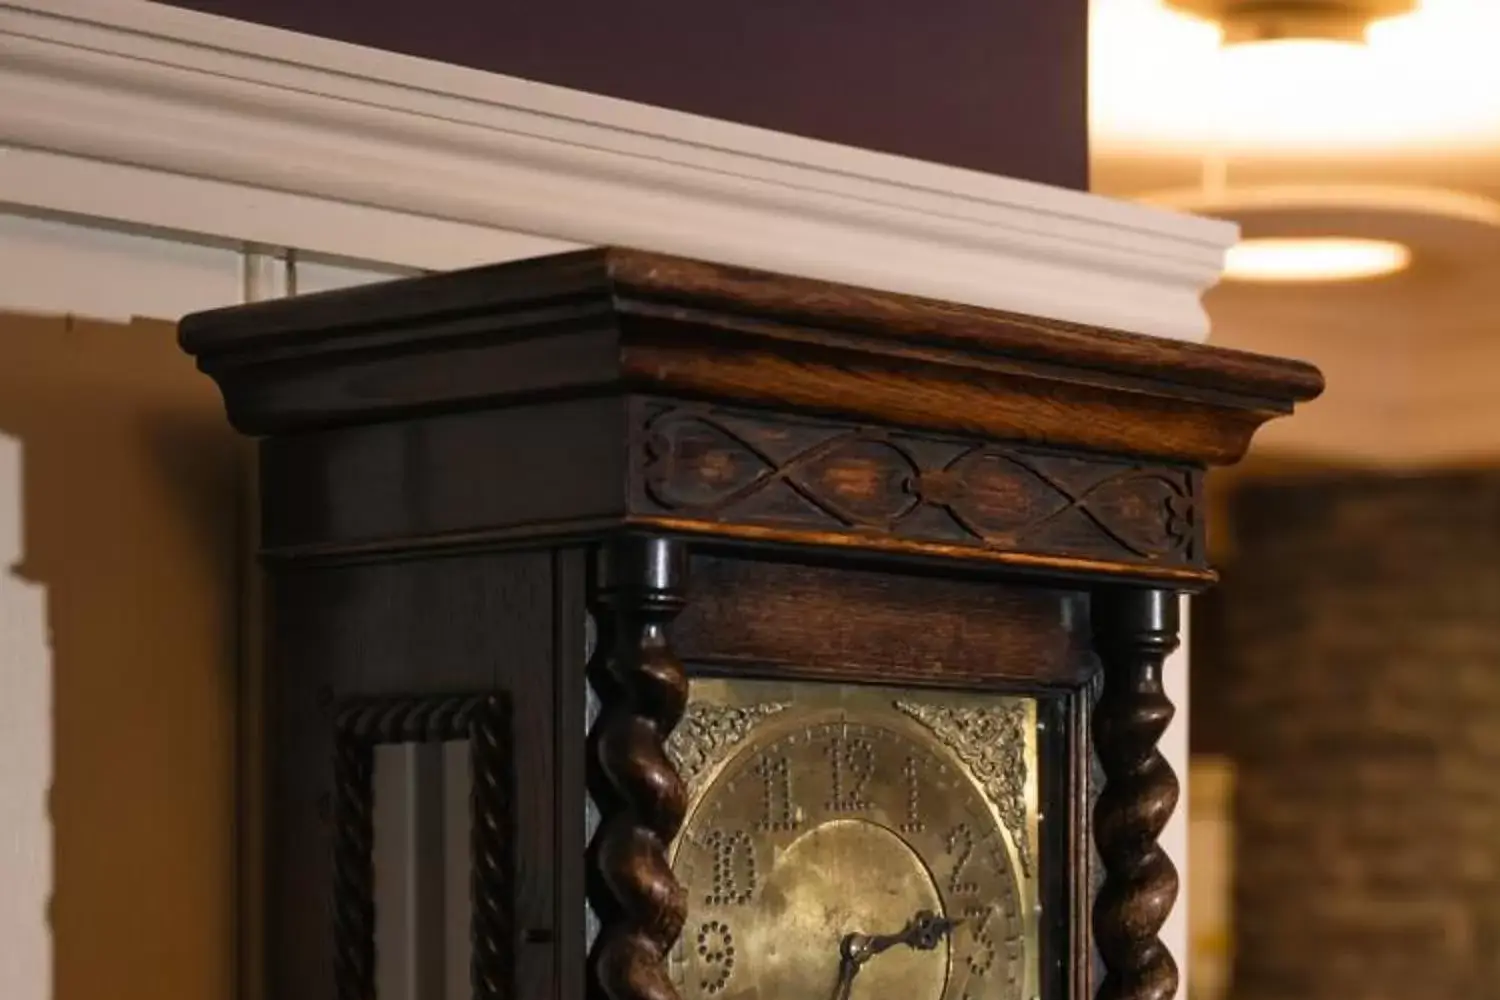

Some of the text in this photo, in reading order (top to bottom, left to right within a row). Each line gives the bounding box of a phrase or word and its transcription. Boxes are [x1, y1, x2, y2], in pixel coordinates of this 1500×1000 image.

[754, 755, 799, 832] 11
[822, 736, 876, 812] 12
[900, 755, 926, 833] 1
[703, 829, 757, 905] 10
[945, 823, 980, 896] 2
[699, 919, 735, 994] 9
[963, 904, 996, 975] 3
